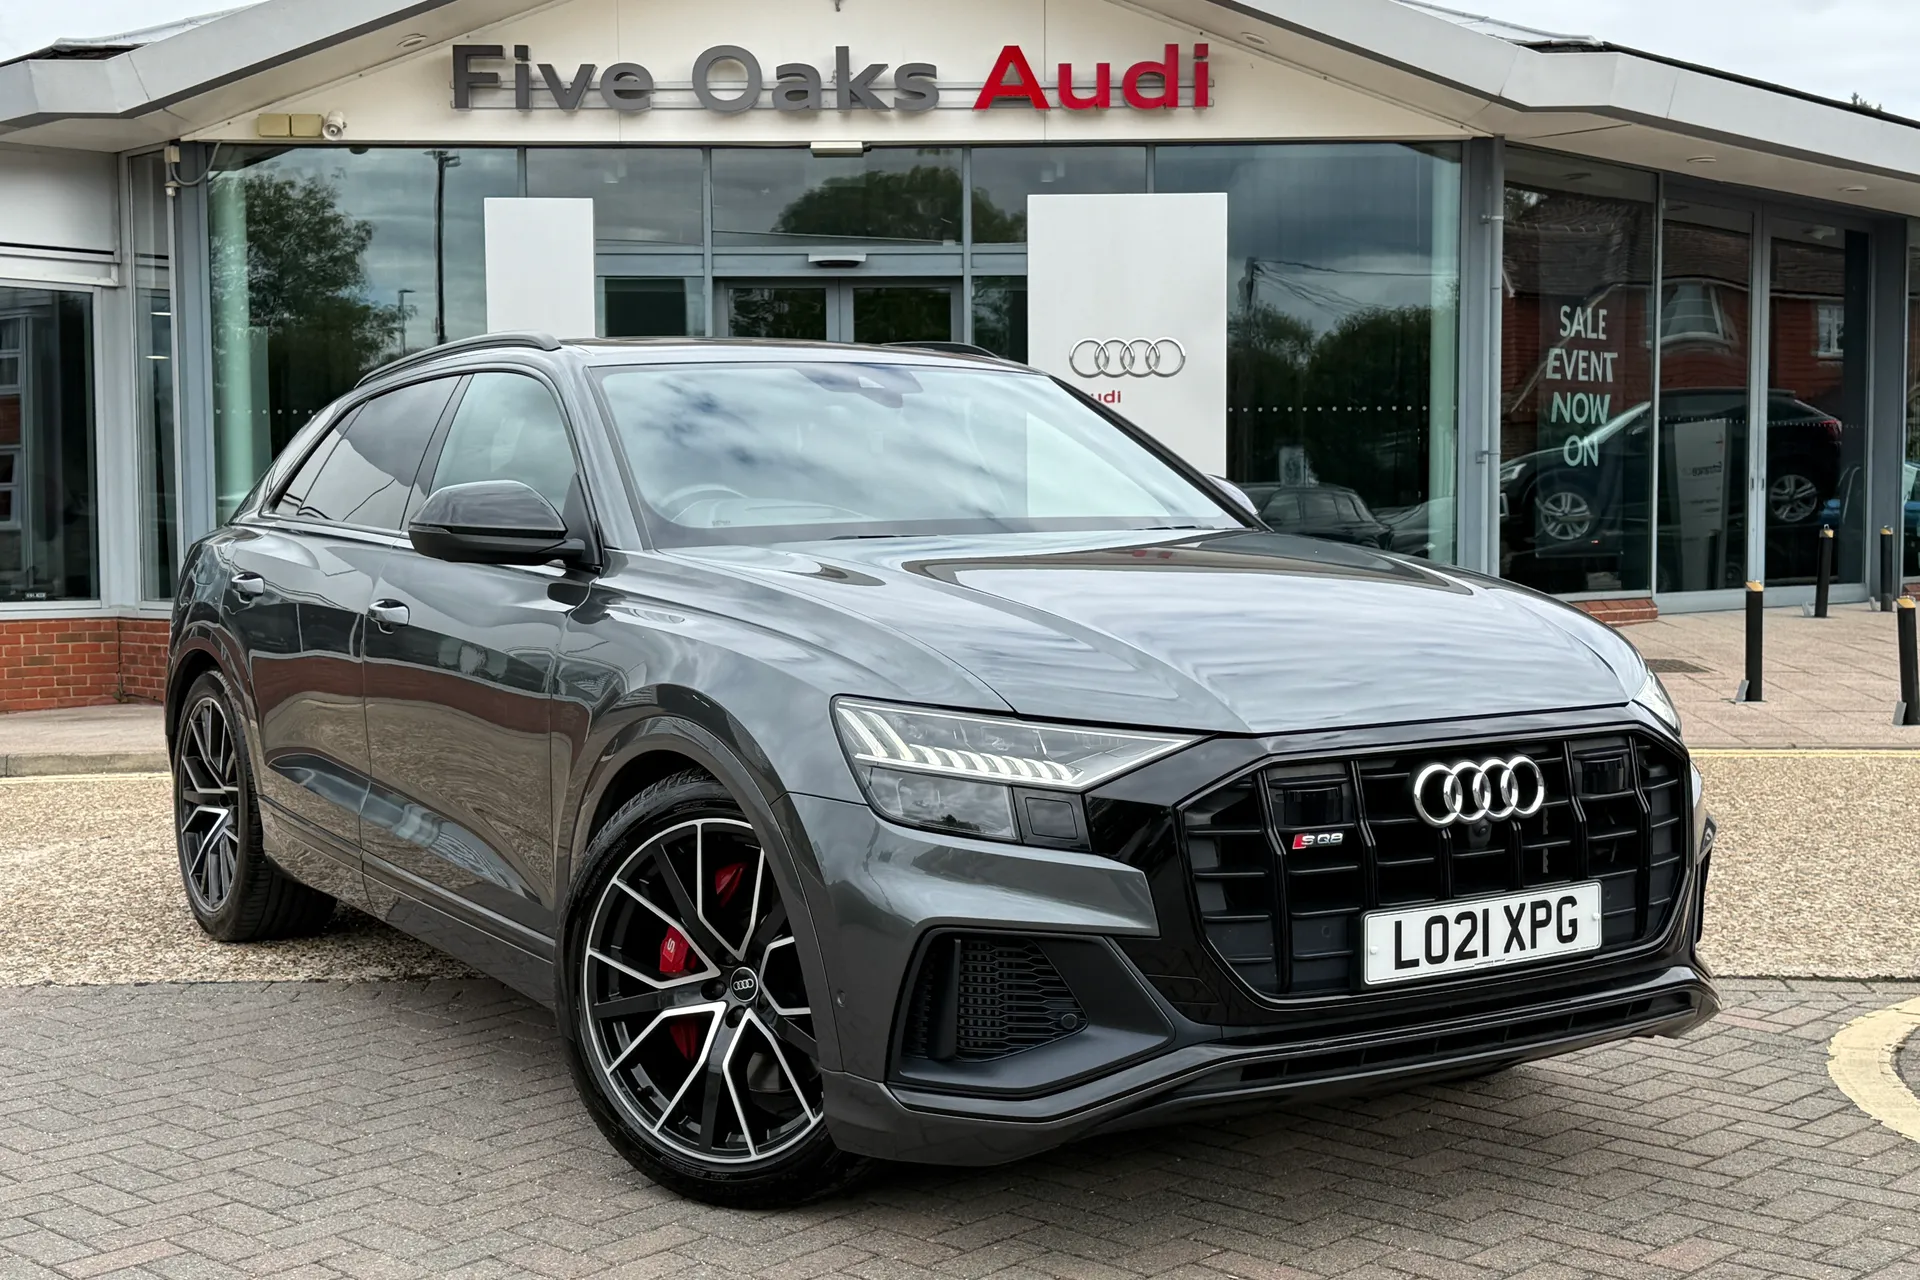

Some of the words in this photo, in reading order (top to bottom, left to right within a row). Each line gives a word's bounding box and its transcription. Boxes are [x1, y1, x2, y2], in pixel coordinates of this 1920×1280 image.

[452, 44, 654, 112] Five
[692, 44, 940, 113] Oaks
[972, 43, 1210, 111] Audi
[1559, 305, 1608, 340] SALE
[1545, 348, 1619, 383] EVENT
[1551, 392, 1611, 424] NOW
[1563, 435, 1599, 467] ON
[1301, 832, 1344, 846] SQ8
[1394, 908, 1490, 971] LO21
[1503, 895, 1578, 954] XPG
